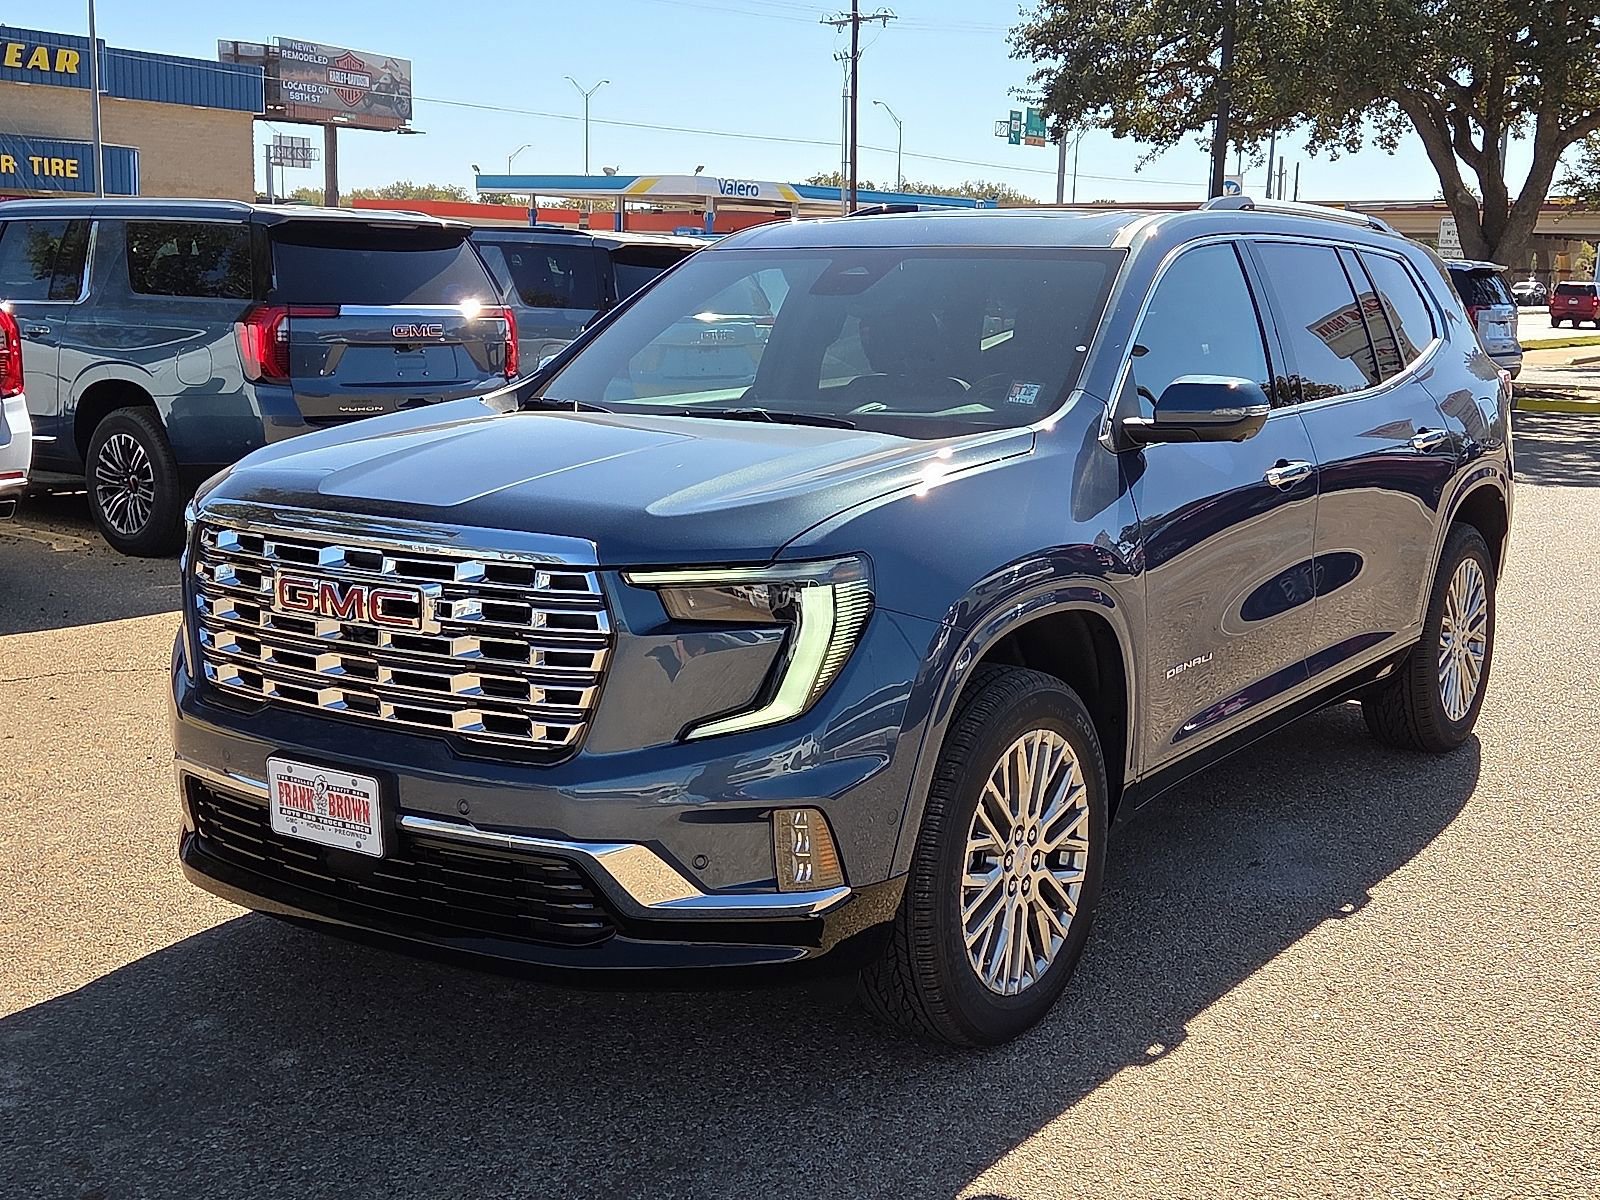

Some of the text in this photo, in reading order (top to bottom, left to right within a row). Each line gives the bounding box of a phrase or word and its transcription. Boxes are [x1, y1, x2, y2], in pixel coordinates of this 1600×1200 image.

[0, 42, 80, 74] EAR
[281, 49, 329, 65] REMODELED
[291, 42, 318, 54] NEWLY
[282, 80, 329, 95] LOCATED ON
[289, 91, 310, 102] 58TH
[29, 156, 79, 178] TIRE
[717, 179, 759, 197] Valero
[392, 323, 443, 338] GMC
[278, 575, 420, 630] GMC
[1165, 652, 1214, 680] DENALI
[277, 781, 371, 826] FRANK BROWN
[281, 808, 371, 834] AUTO AND TRUCK RANCH
[285, 816, 368, 841] GMC HONDA PREOWNED
